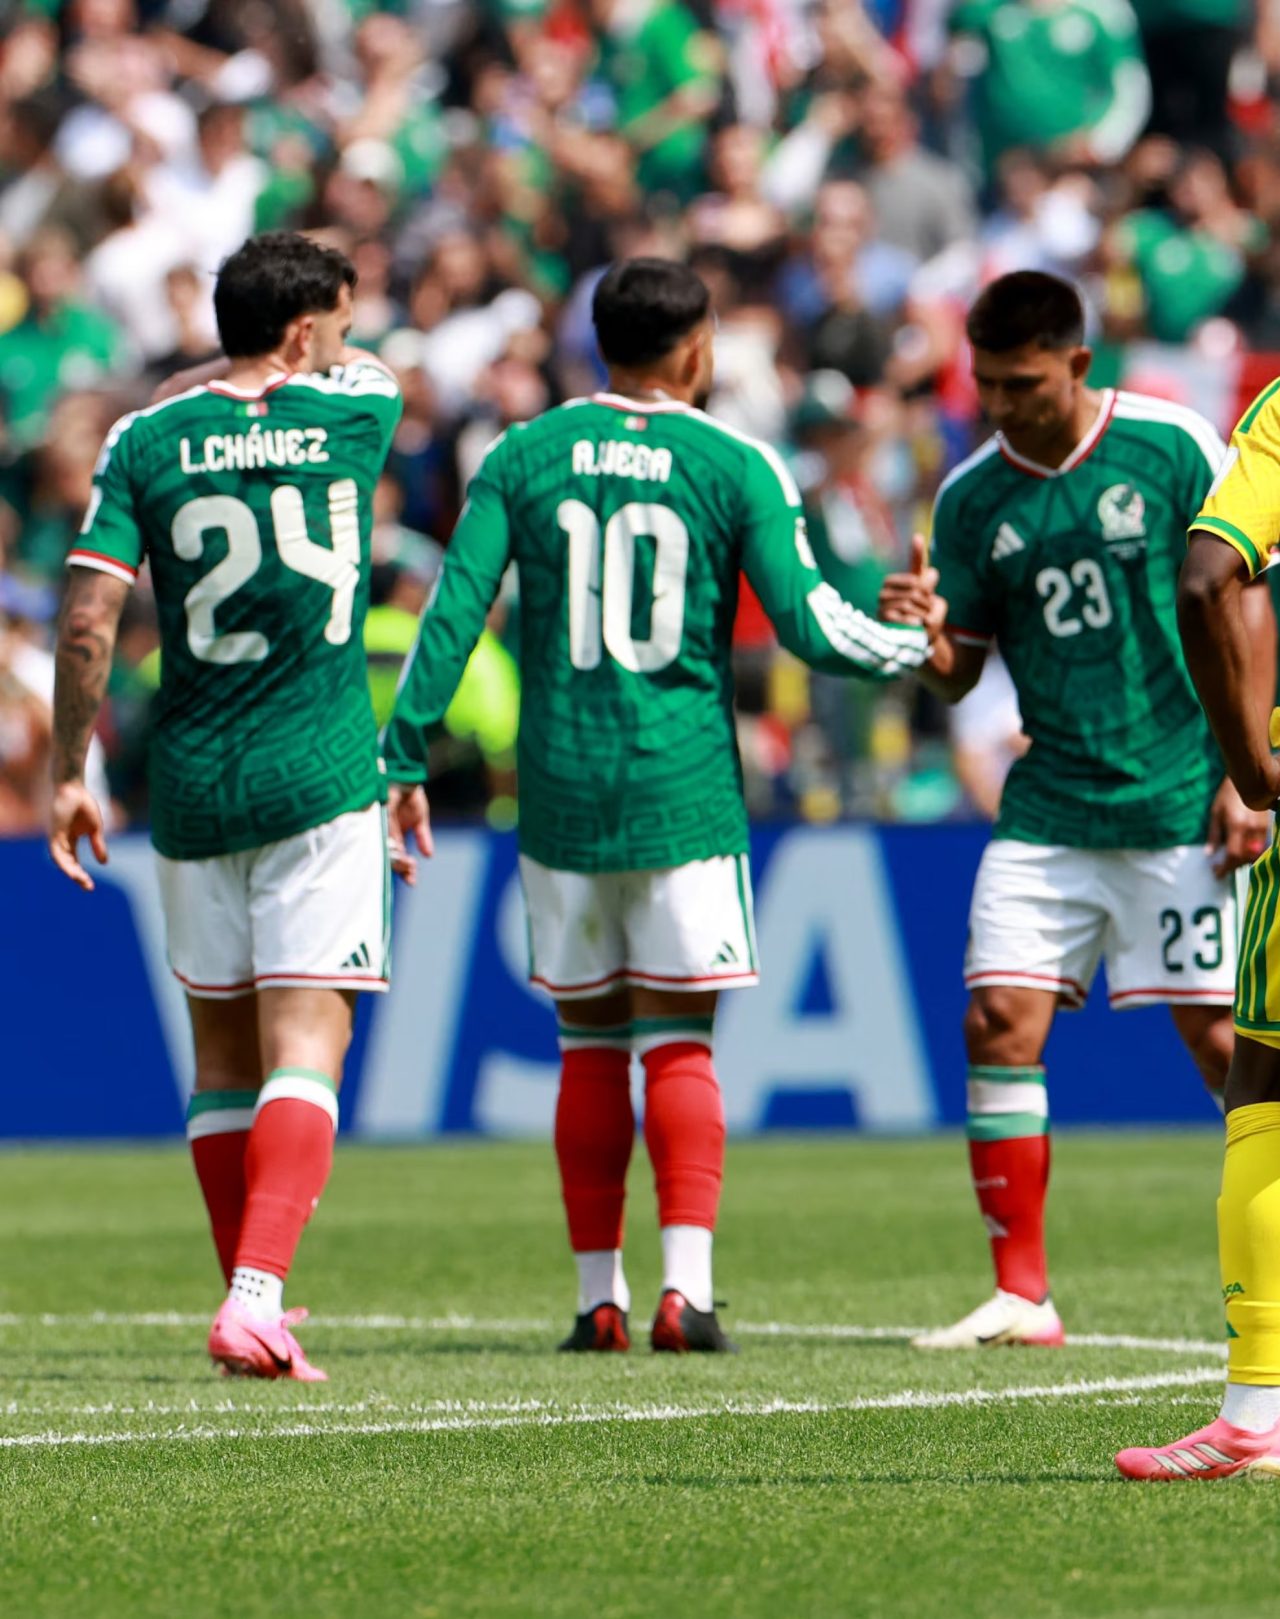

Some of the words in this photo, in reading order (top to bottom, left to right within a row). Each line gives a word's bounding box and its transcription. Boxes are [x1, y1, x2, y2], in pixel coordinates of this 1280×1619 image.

[171, 477, 361, 665] 24
[556, 498, 690, 673] 10
[1036, 558, 1113, 637] 23
[1160, 906, 1223, 974] 23
